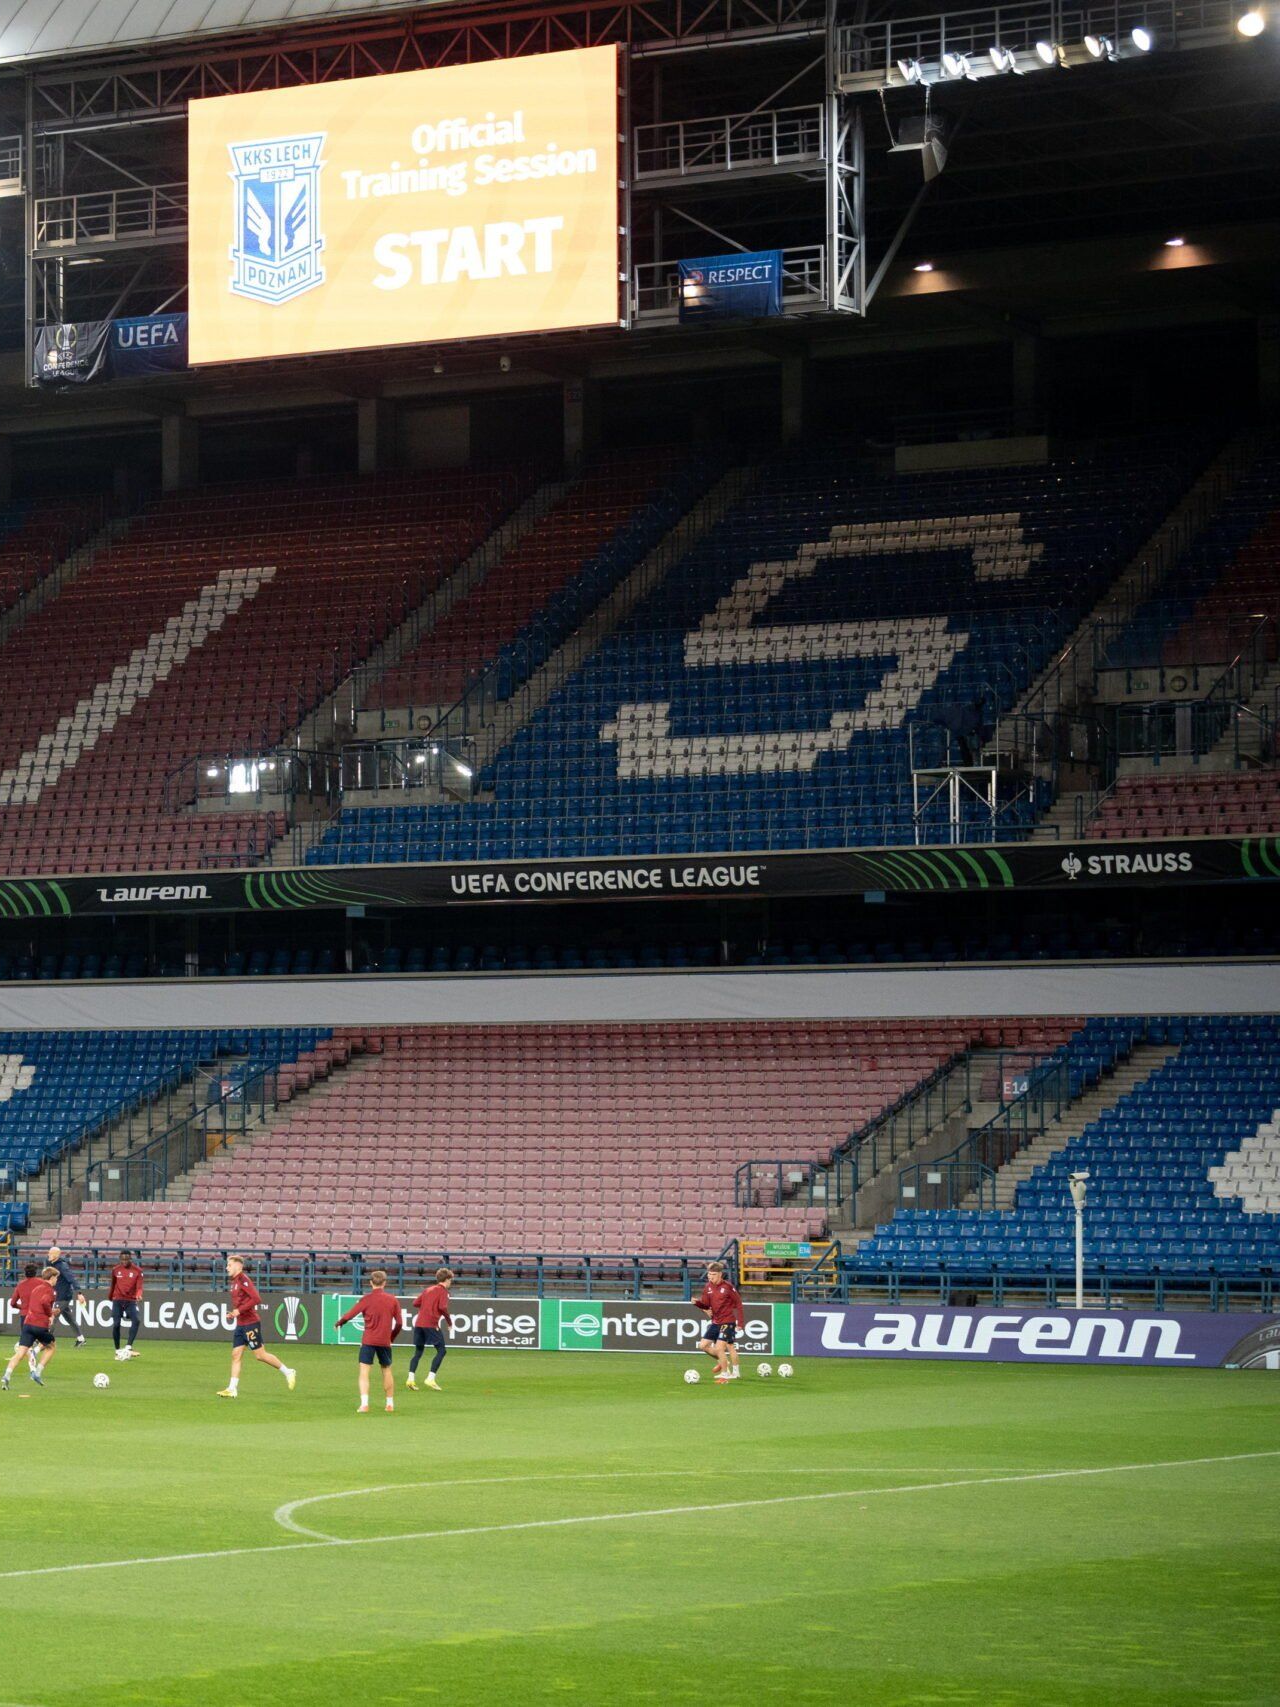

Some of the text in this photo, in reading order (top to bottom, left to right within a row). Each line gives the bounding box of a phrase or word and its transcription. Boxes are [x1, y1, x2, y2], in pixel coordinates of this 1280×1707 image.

[411, 110, 526, 154] Official
[244, 144, 311, 166] KKS LECH
[341, 142, 597, 200] Training Session
[372, 216, 564, 291] START
[708, 265, 772, 284] RESPECT
[118, 323, 179, 348] UEFA
[1087, 852, 1193, 875] STRAUSS
[451, 873, 510, 894] UEFA
[515, 869, 663, 892] CONFERENCE
[1003, 1081, 1029, 1095] E14
[466, 1334, 536, 1345] rent-a-car
